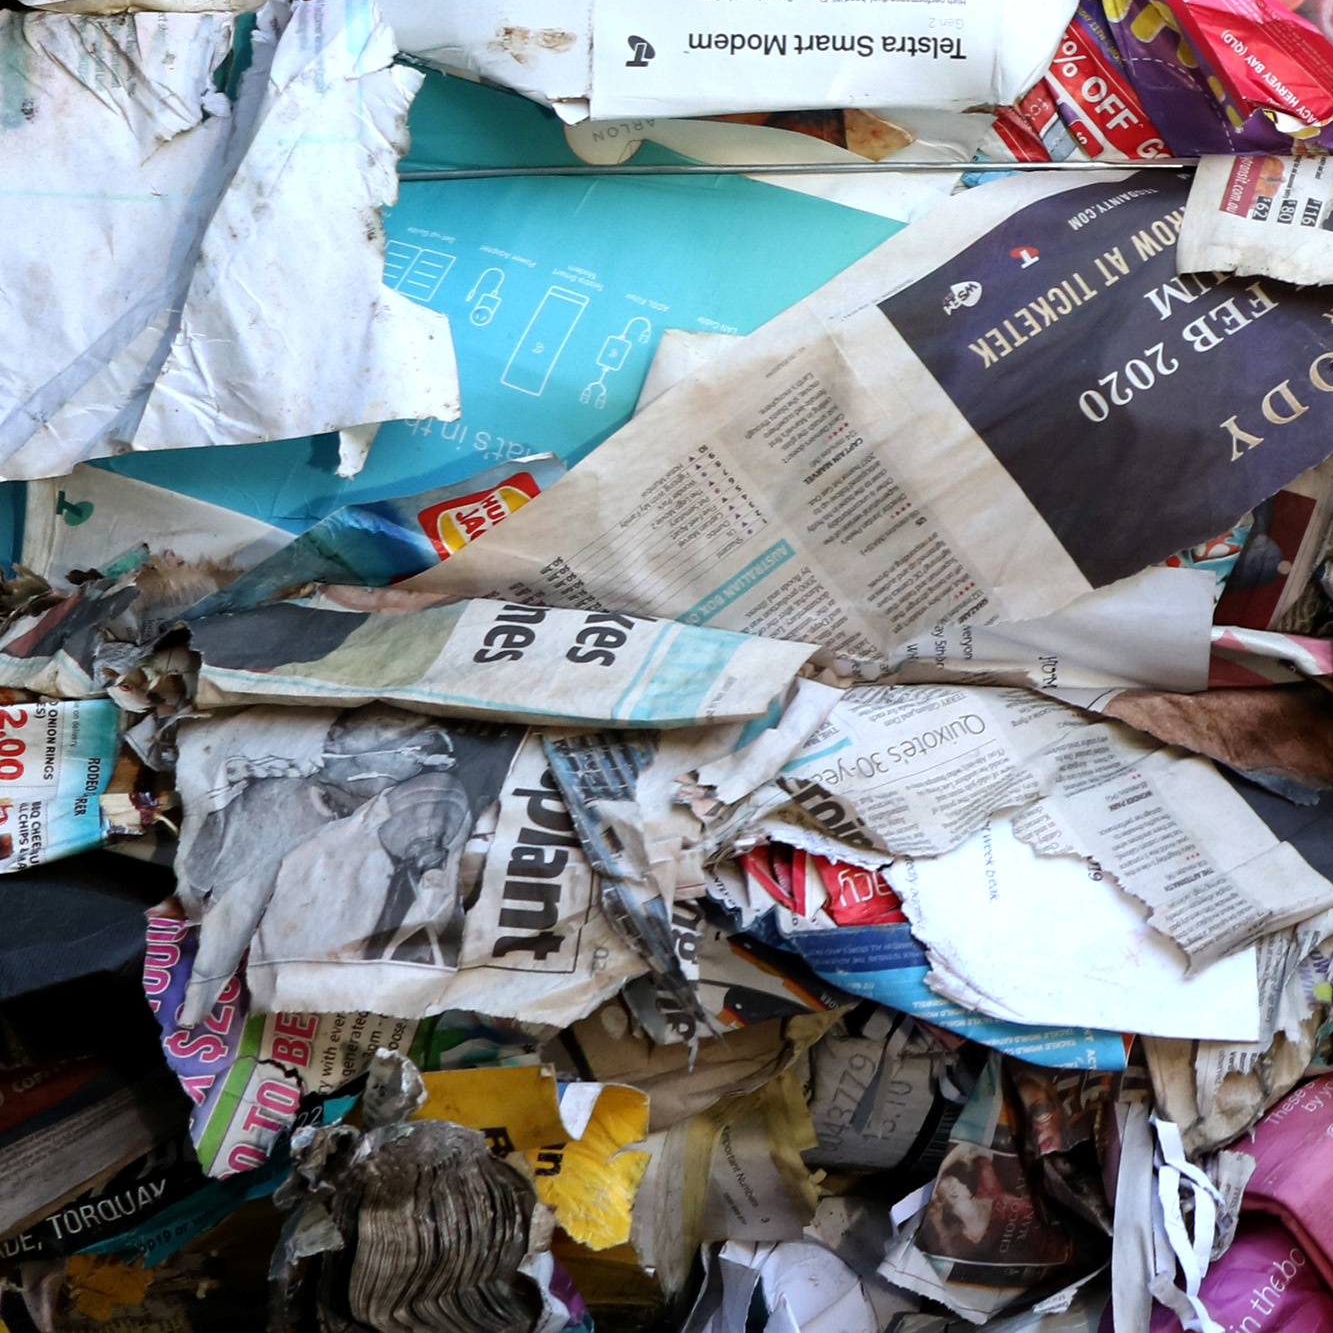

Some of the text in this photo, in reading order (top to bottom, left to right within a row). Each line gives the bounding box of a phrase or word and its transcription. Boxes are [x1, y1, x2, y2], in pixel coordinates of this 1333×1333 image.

[794, 34, 875, 57] Smart
[882, 35, 967, 59] Telstra
[1220, 29, 1268, 80] BAY (QLD)
[1081, 74, 1141, 134] OFF
[1252, 196, 1323, 228] $62 $80 $116
[967, 245, 1132, 369] AT TICKETEK
[1078, 281, 1280, 423] FEB 2020
[803, 438, 864, 486] CAPTAIN MARVEL
[733, 539, 790, 596] AUSTRALIAN
[708, 588, 737, 614] BOX
[44, 709, 59, 781] ONION RINGS
[887, 714, 987, 767] Quixote's
[491, 762, 578, 962] plant
[46, 1177, 168, 1244] TORQUAY
[1259, 1278, 1287, 1321] the
